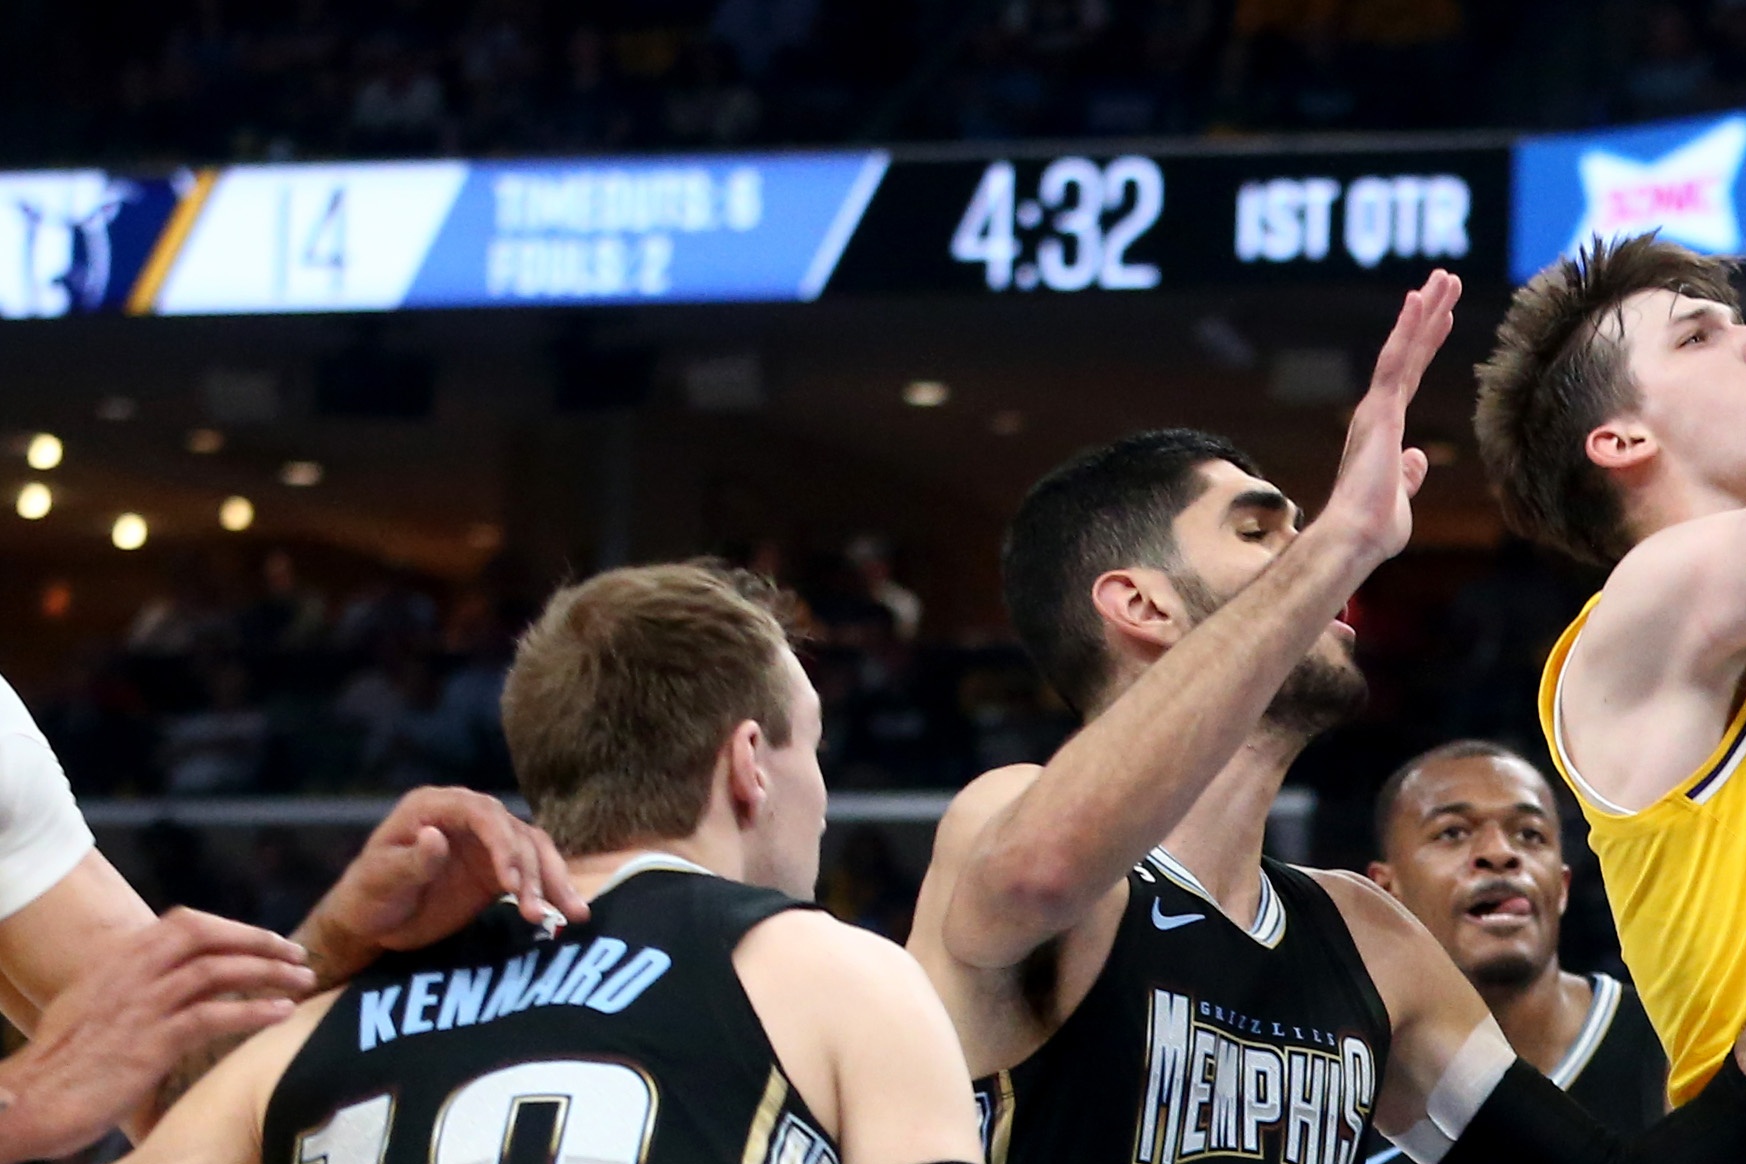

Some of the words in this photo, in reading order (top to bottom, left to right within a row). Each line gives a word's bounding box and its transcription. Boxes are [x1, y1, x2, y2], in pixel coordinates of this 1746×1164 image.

[637, 233, 675, 297] 2
[949, 155, 1165, 292] 4:32
[1343, 173, 1471, 268] QTR
[357, 936, 672, 1053] KENNARD
[1200, 1001, 1335, 1047] GRIZZLIES
